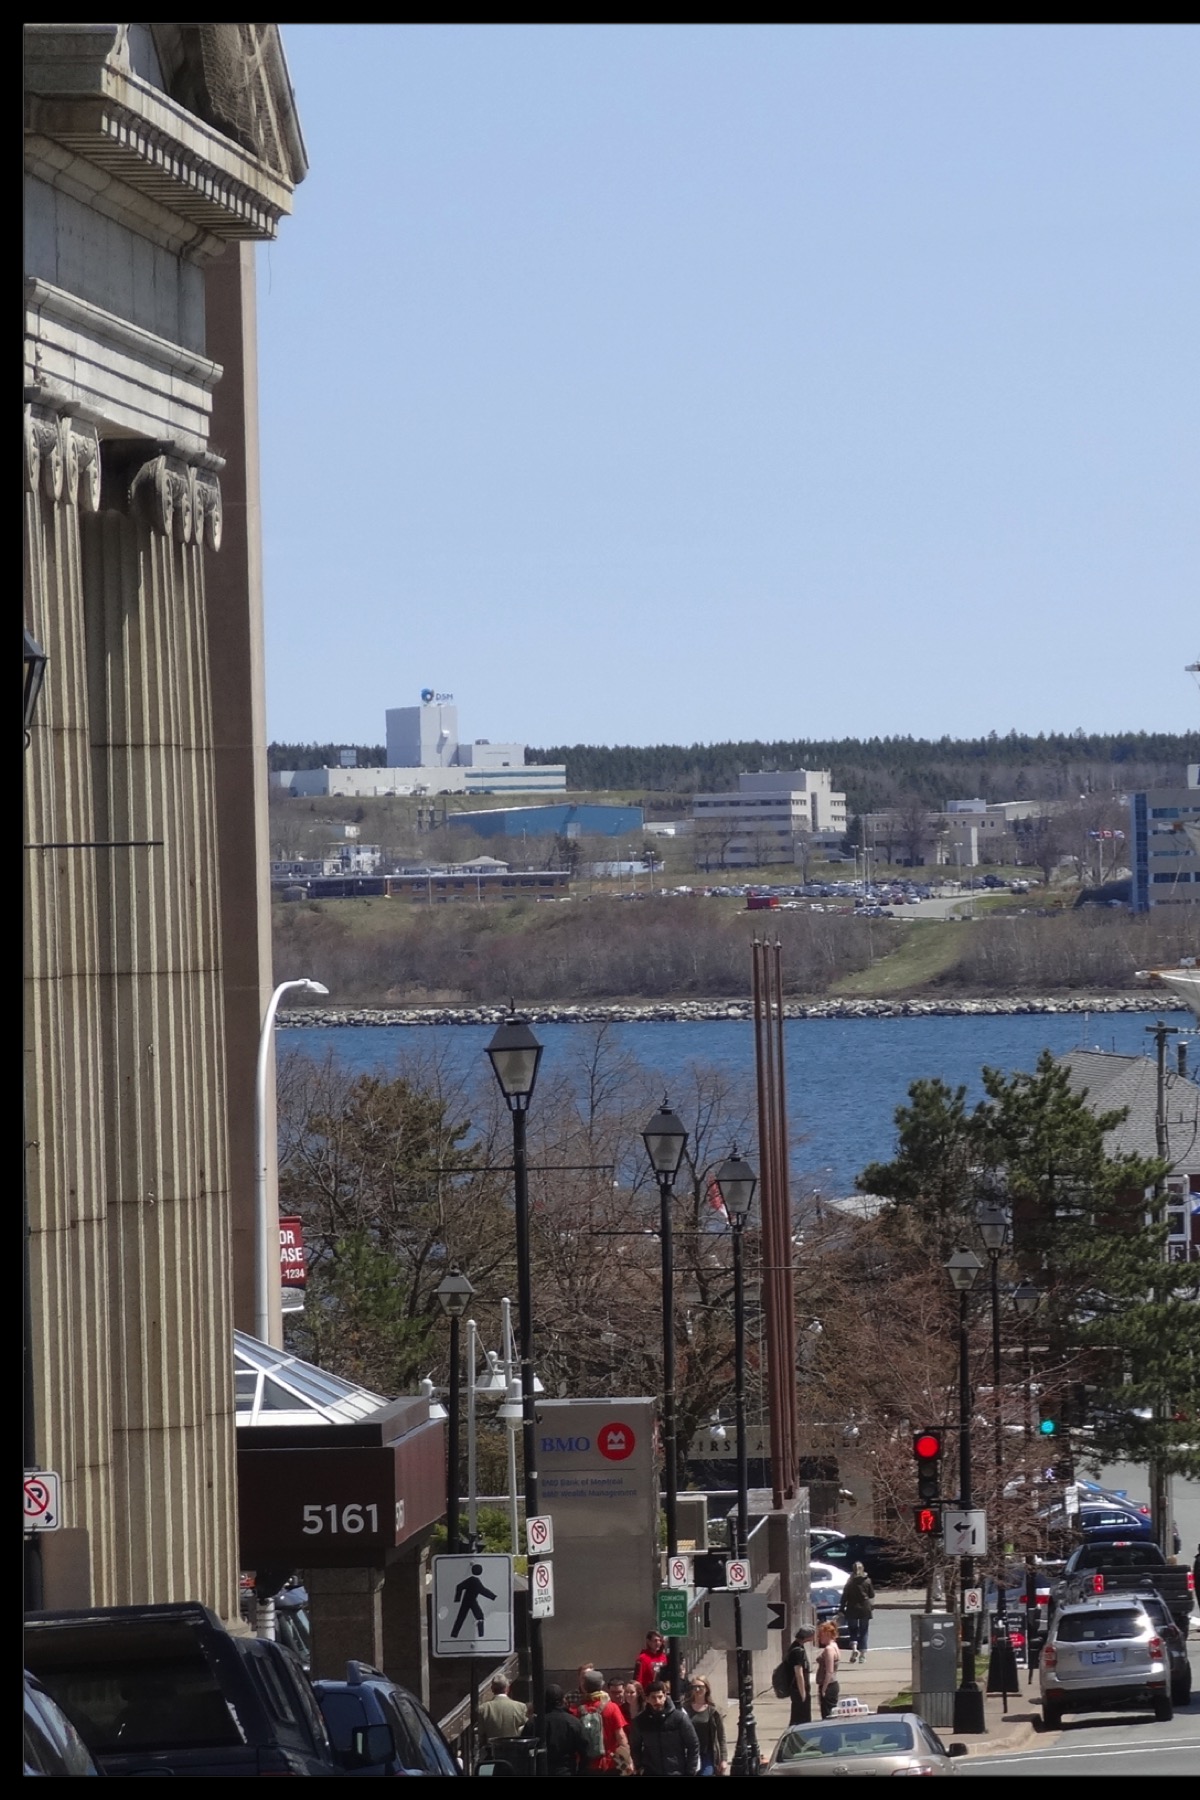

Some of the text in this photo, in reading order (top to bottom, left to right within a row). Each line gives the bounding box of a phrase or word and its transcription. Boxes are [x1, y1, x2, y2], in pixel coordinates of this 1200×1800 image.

[541, 1436, 591, 1453] BMO
[302, 1503, 379, 1535] 5161
[664, 1602, 683, 1610] TAXI
[661, 1610, 686, 1618] STAND
